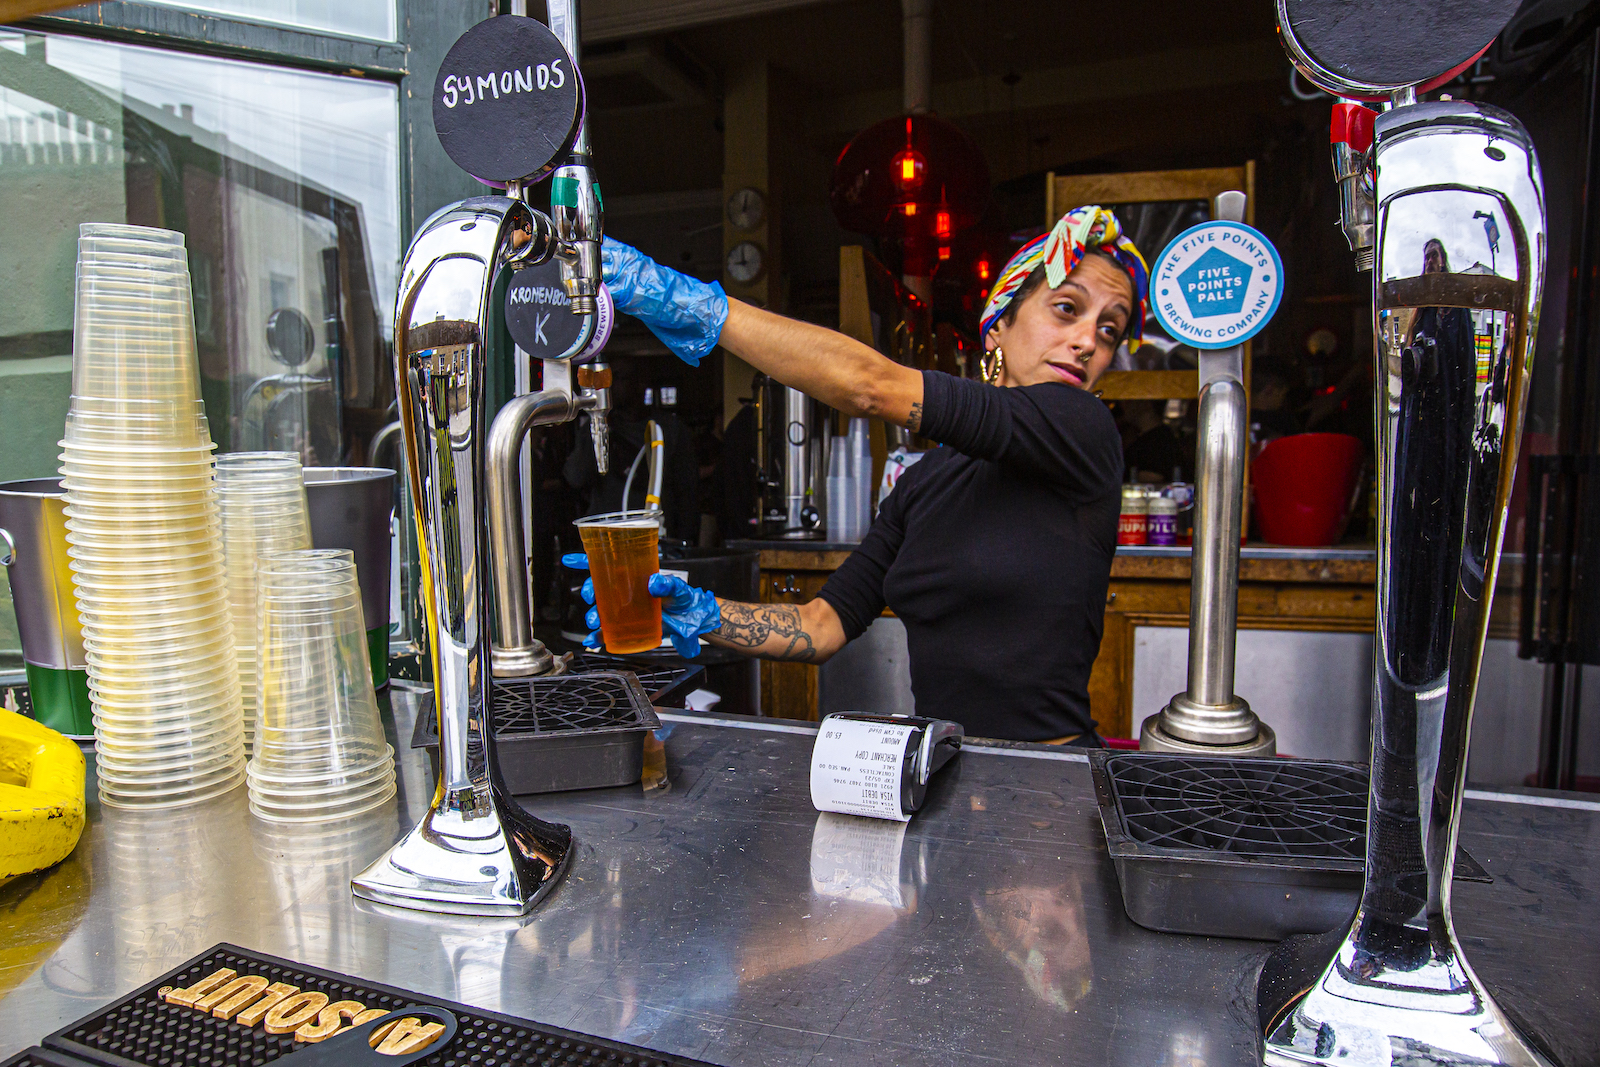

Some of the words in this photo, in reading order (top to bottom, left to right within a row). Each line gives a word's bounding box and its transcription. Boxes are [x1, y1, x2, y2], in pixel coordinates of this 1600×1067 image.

[443, 58, 565, 109] SYMONDS
[1161, 253, 1181, 281] THE
[1182, 232, 1216, 253] FIVE
[1222, 232, 1268, 268] POINTS
[1198, 266, 1231, 280] FIVE
[1187, 277, 1243, 293] POINTS
[1198, 289, 1234, 303] PALE
[594, 296, 607, 342] BREWING
[1164, 302, 1213, 338] BREWING
[1217, 290, 1269, 337] COMPANY
[534, 312, 551, 346] K
[825, 731, 842, 739] £5.00
[880, 737, 901, 745] AMOUNT
[855, 750, 869, 760] COPY
[871, 752, 897, 762] MERCHANT
[862, 789, 878, 799] DEBIT
[880, 791, 894, 801] VISA
